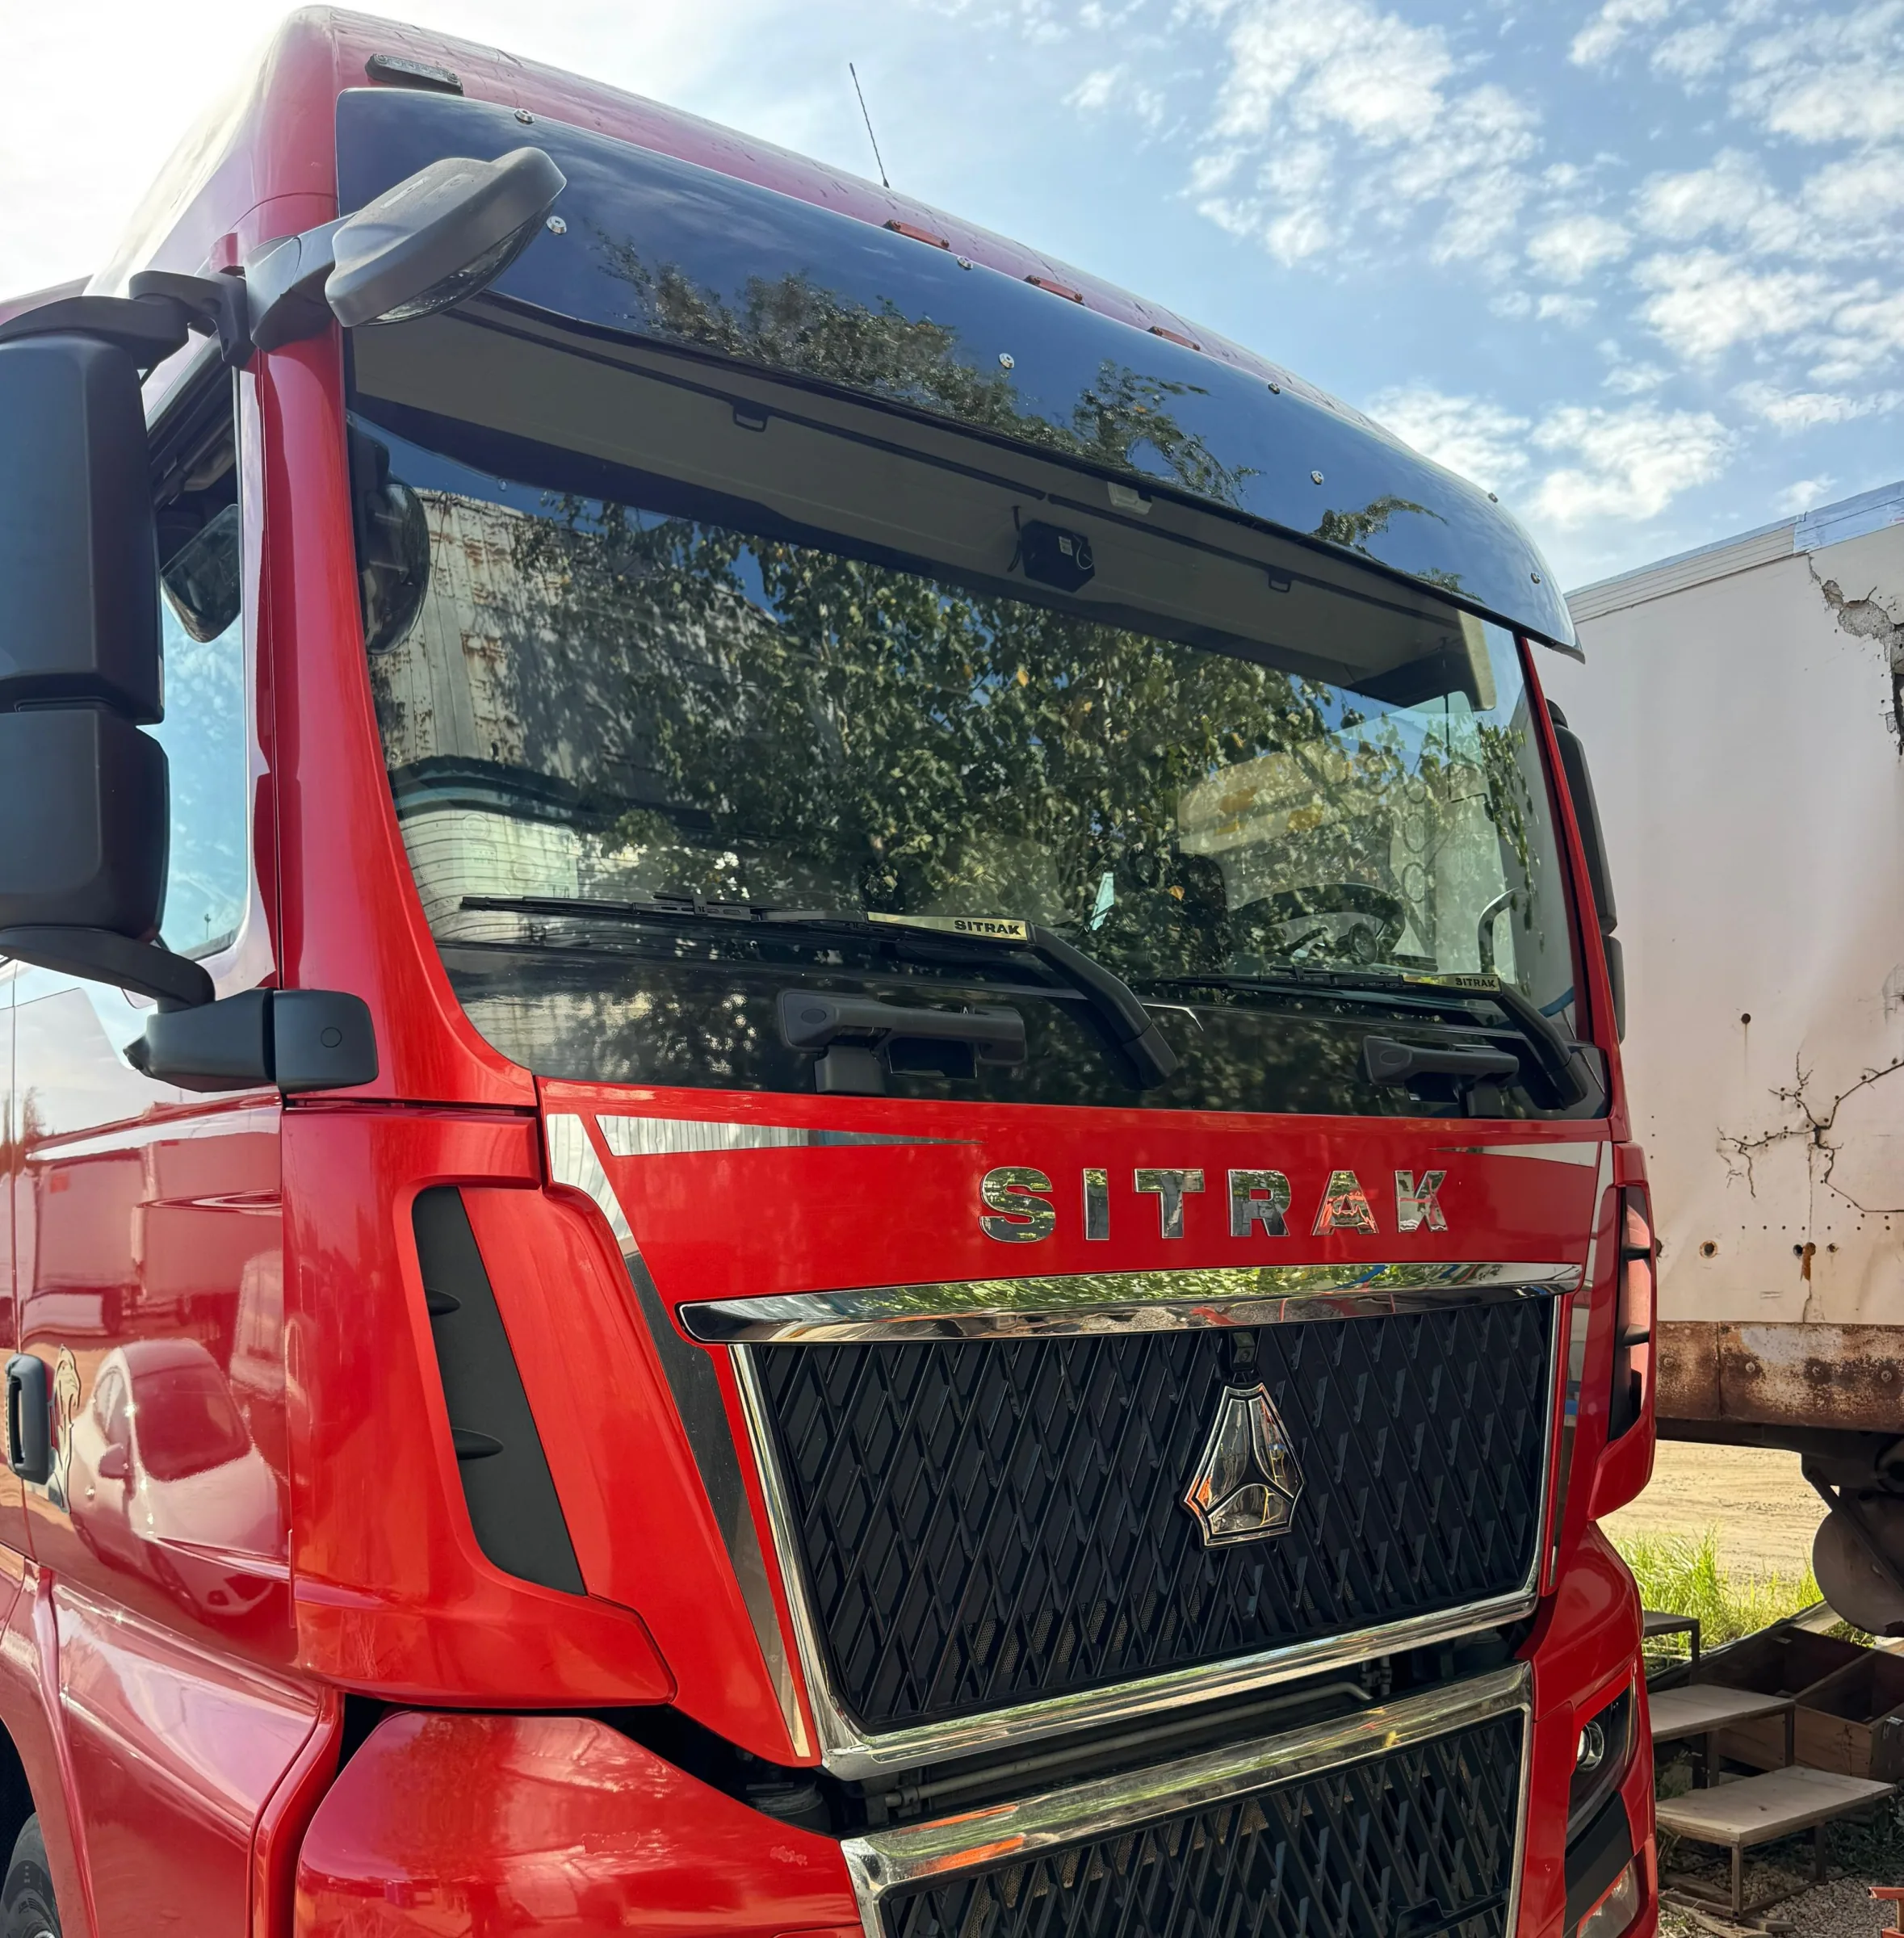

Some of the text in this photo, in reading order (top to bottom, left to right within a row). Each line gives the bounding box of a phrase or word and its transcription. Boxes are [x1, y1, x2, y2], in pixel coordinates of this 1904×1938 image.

[954, 920, 1021, 936] SITRAK
[1454, 977, 1496, 988] SITRAK
[979, 1165, 1449, 1244] SITRAK
